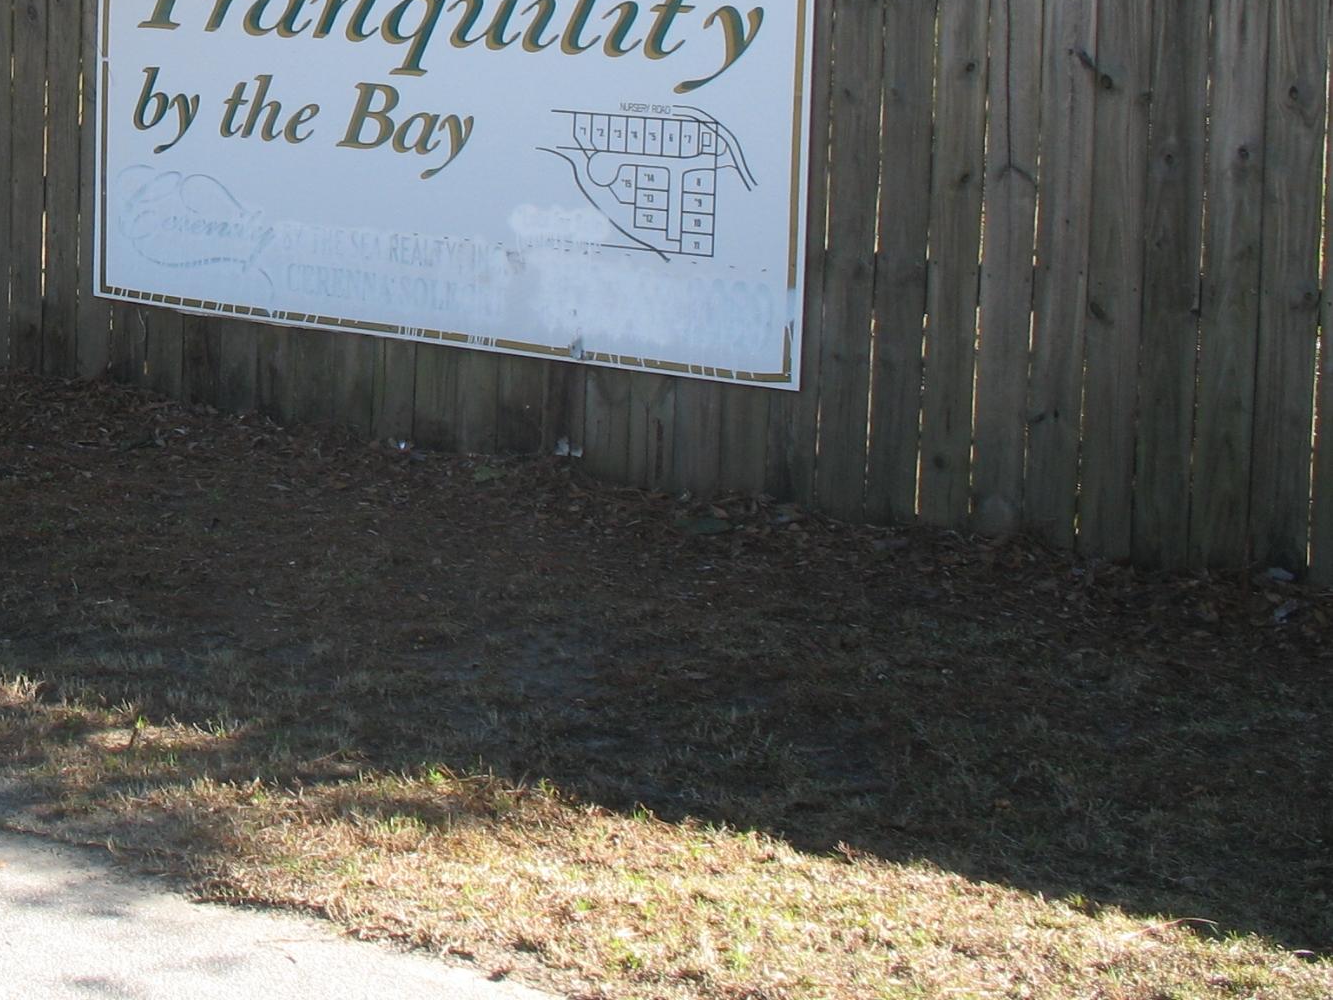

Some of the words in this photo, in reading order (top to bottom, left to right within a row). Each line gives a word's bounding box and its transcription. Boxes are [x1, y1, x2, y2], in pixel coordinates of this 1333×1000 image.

[133, 66, 201, 155] by
[219, 74, 320, 144] the
[335, 81, 475, 180] Bay
[618, 102, 650, 113] NURSERY
[651, 104, 672, 115] ROAD
